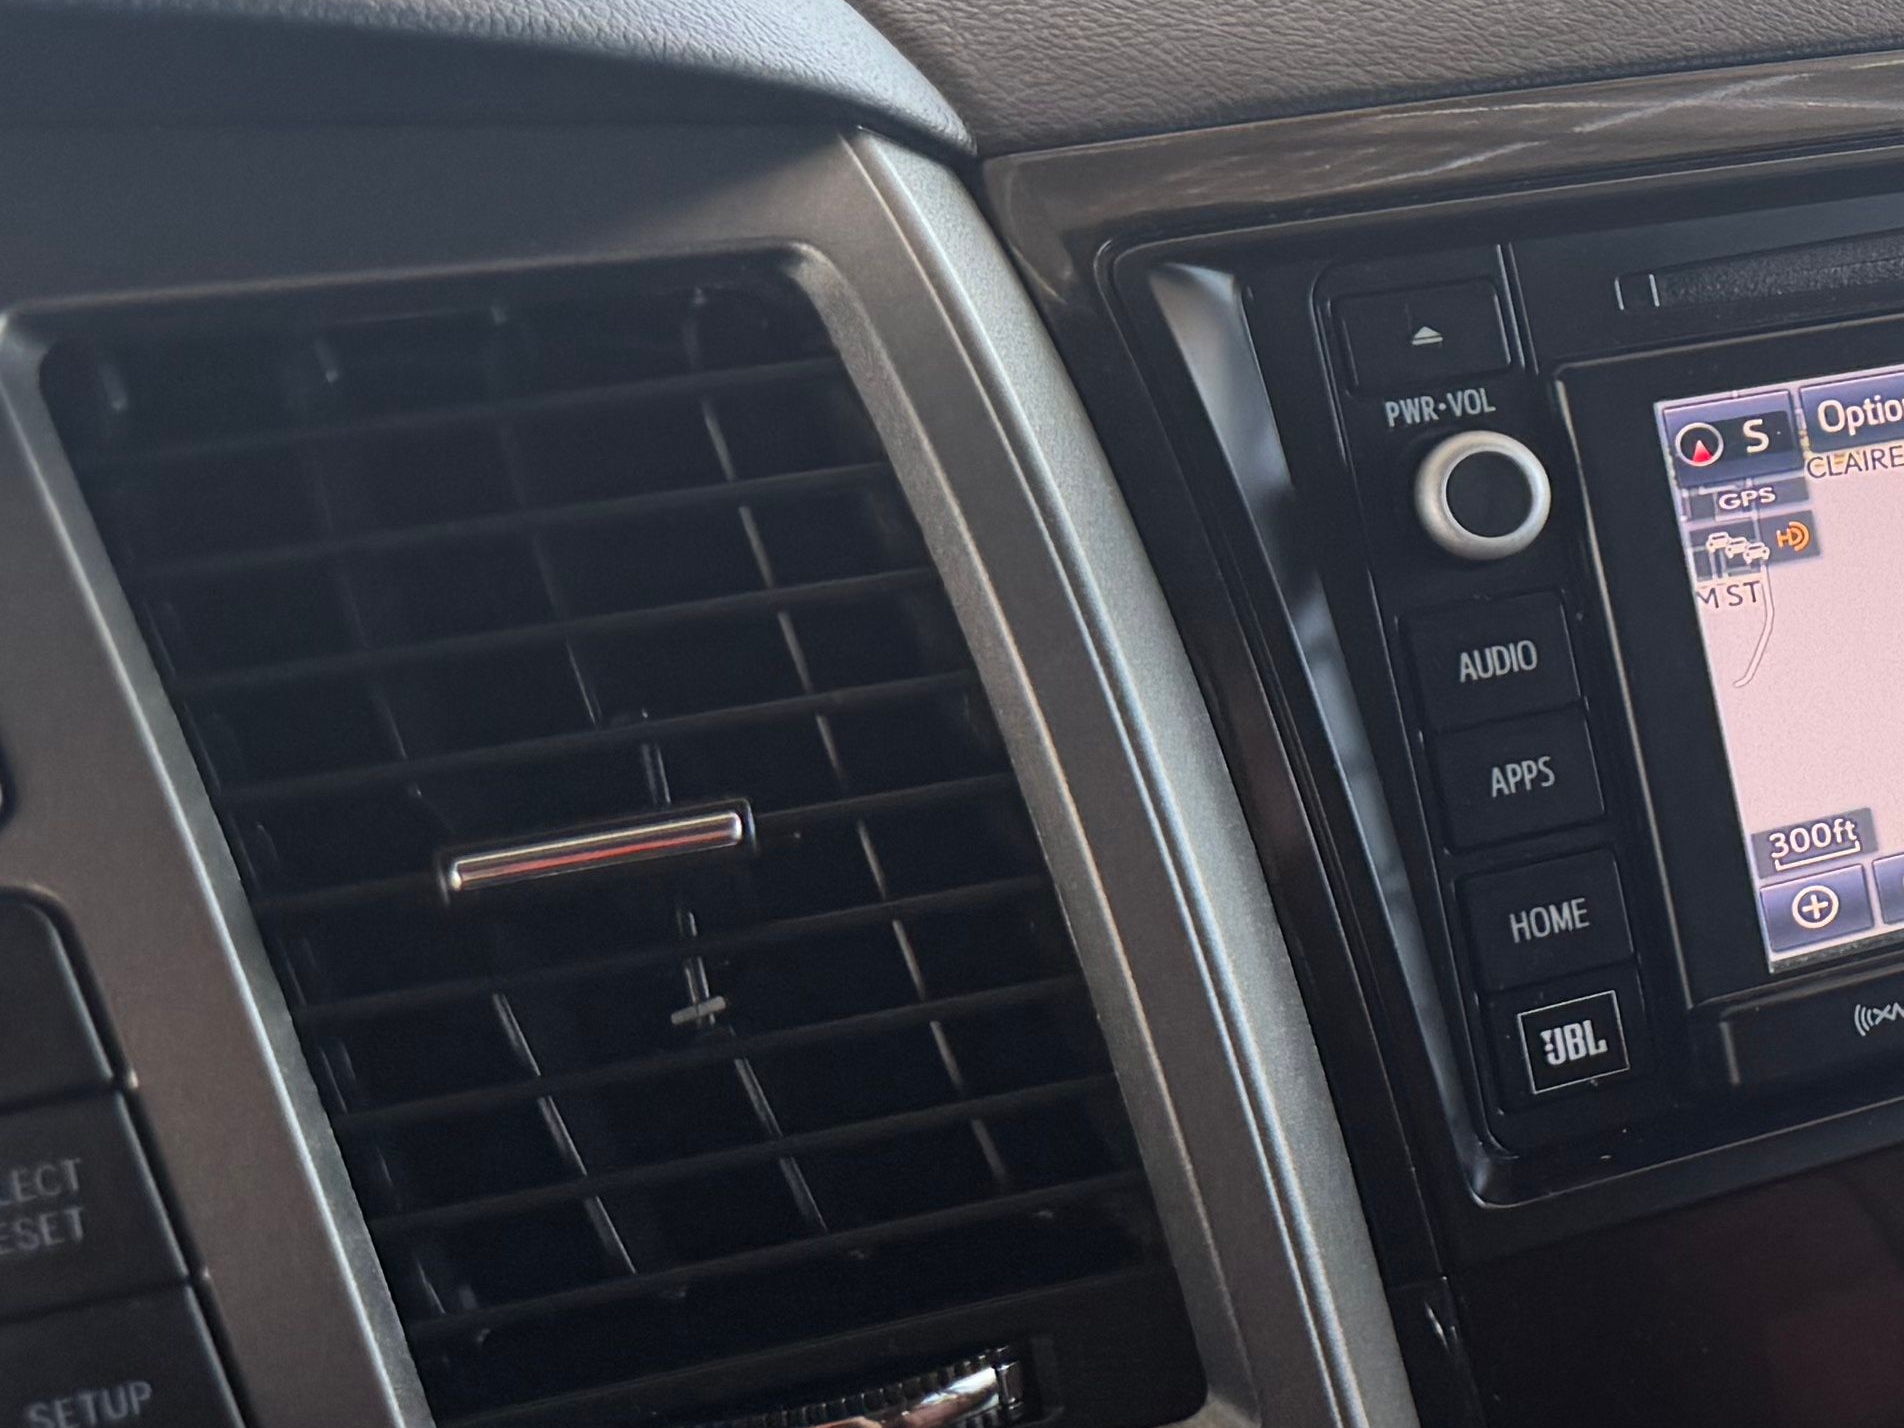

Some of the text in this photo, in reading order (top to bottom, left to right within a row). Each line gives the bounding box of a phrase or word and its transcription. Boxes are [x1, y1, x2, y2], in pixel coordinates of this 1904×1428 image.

[1742, 418, 1769, 455] S
[1718, 486, 1776, 510] GPS
[1726, 580, 1760, 607] ST
[1459, 639, 1539, 683] AUDIO
[1490, 756, 1556, 798] APPS
[1768, 819, 1858, 860] 300ft
[1509, 897, 1590, 944] HOME
[1540, 1019, 1608, 1066] JBL
